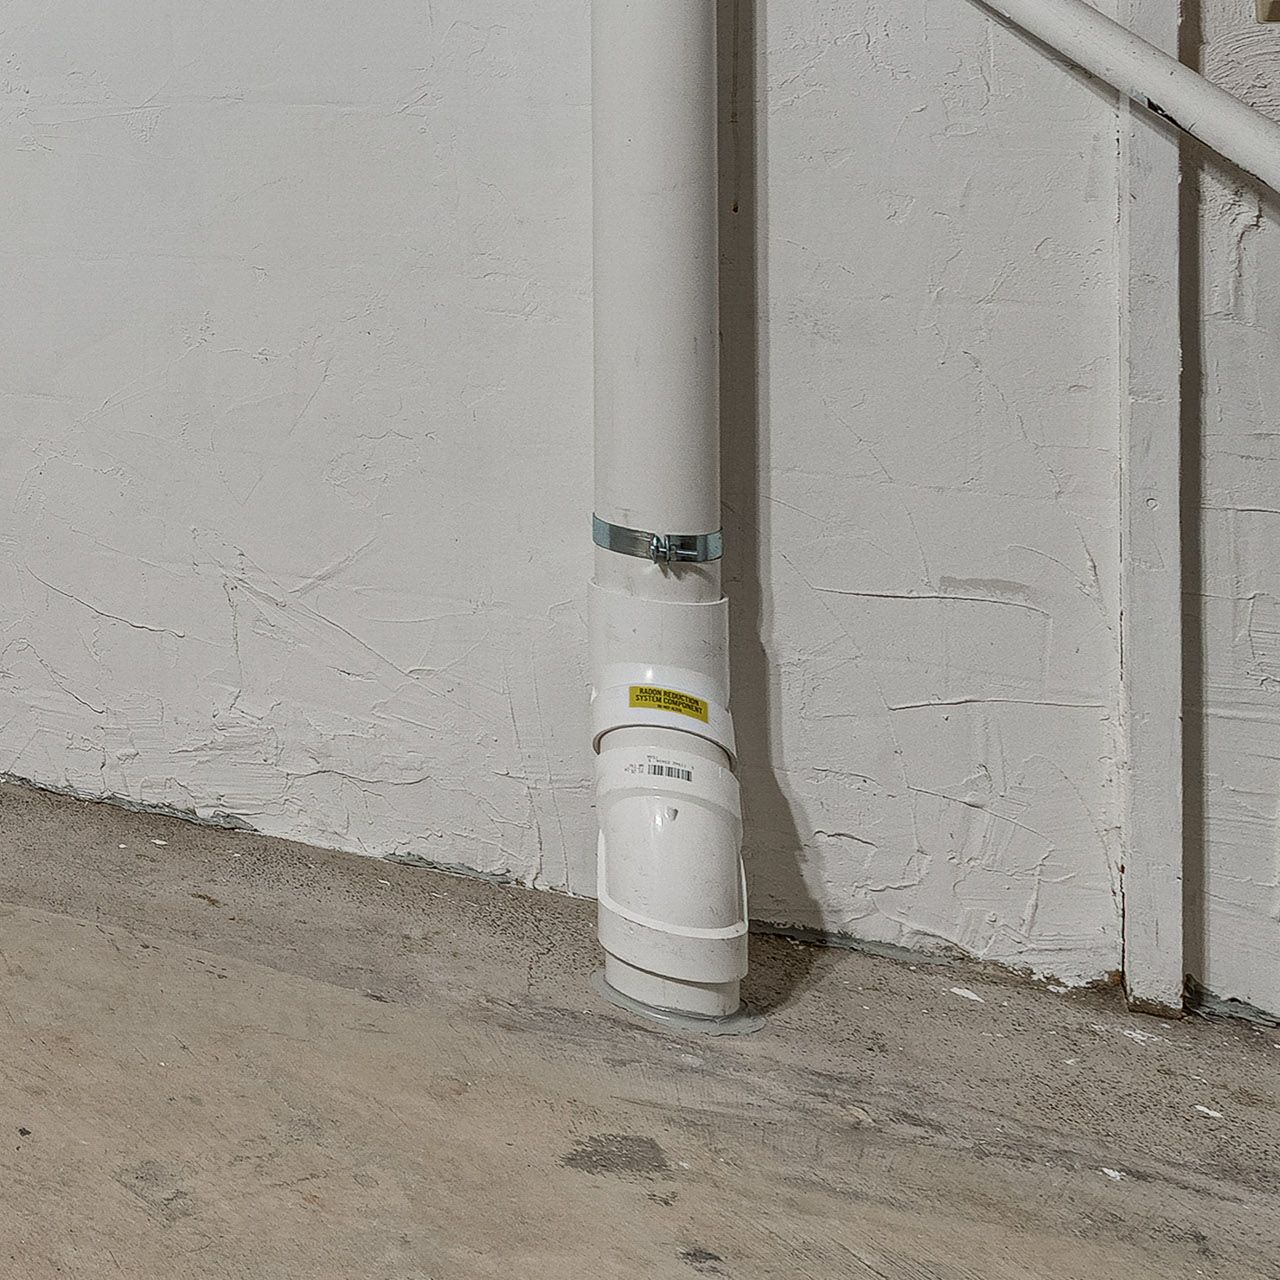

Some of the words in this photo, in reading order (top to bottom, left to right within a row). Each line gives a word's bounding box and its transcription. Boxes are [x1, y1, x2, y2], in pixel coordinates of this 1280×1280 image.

[635, 694, 662, 703] SYSTEM
[663, 697, 703, 714] COMPONENT
[639, 687, 662, 696] RADON
[663, 690, 700, 706] REDUCTION
